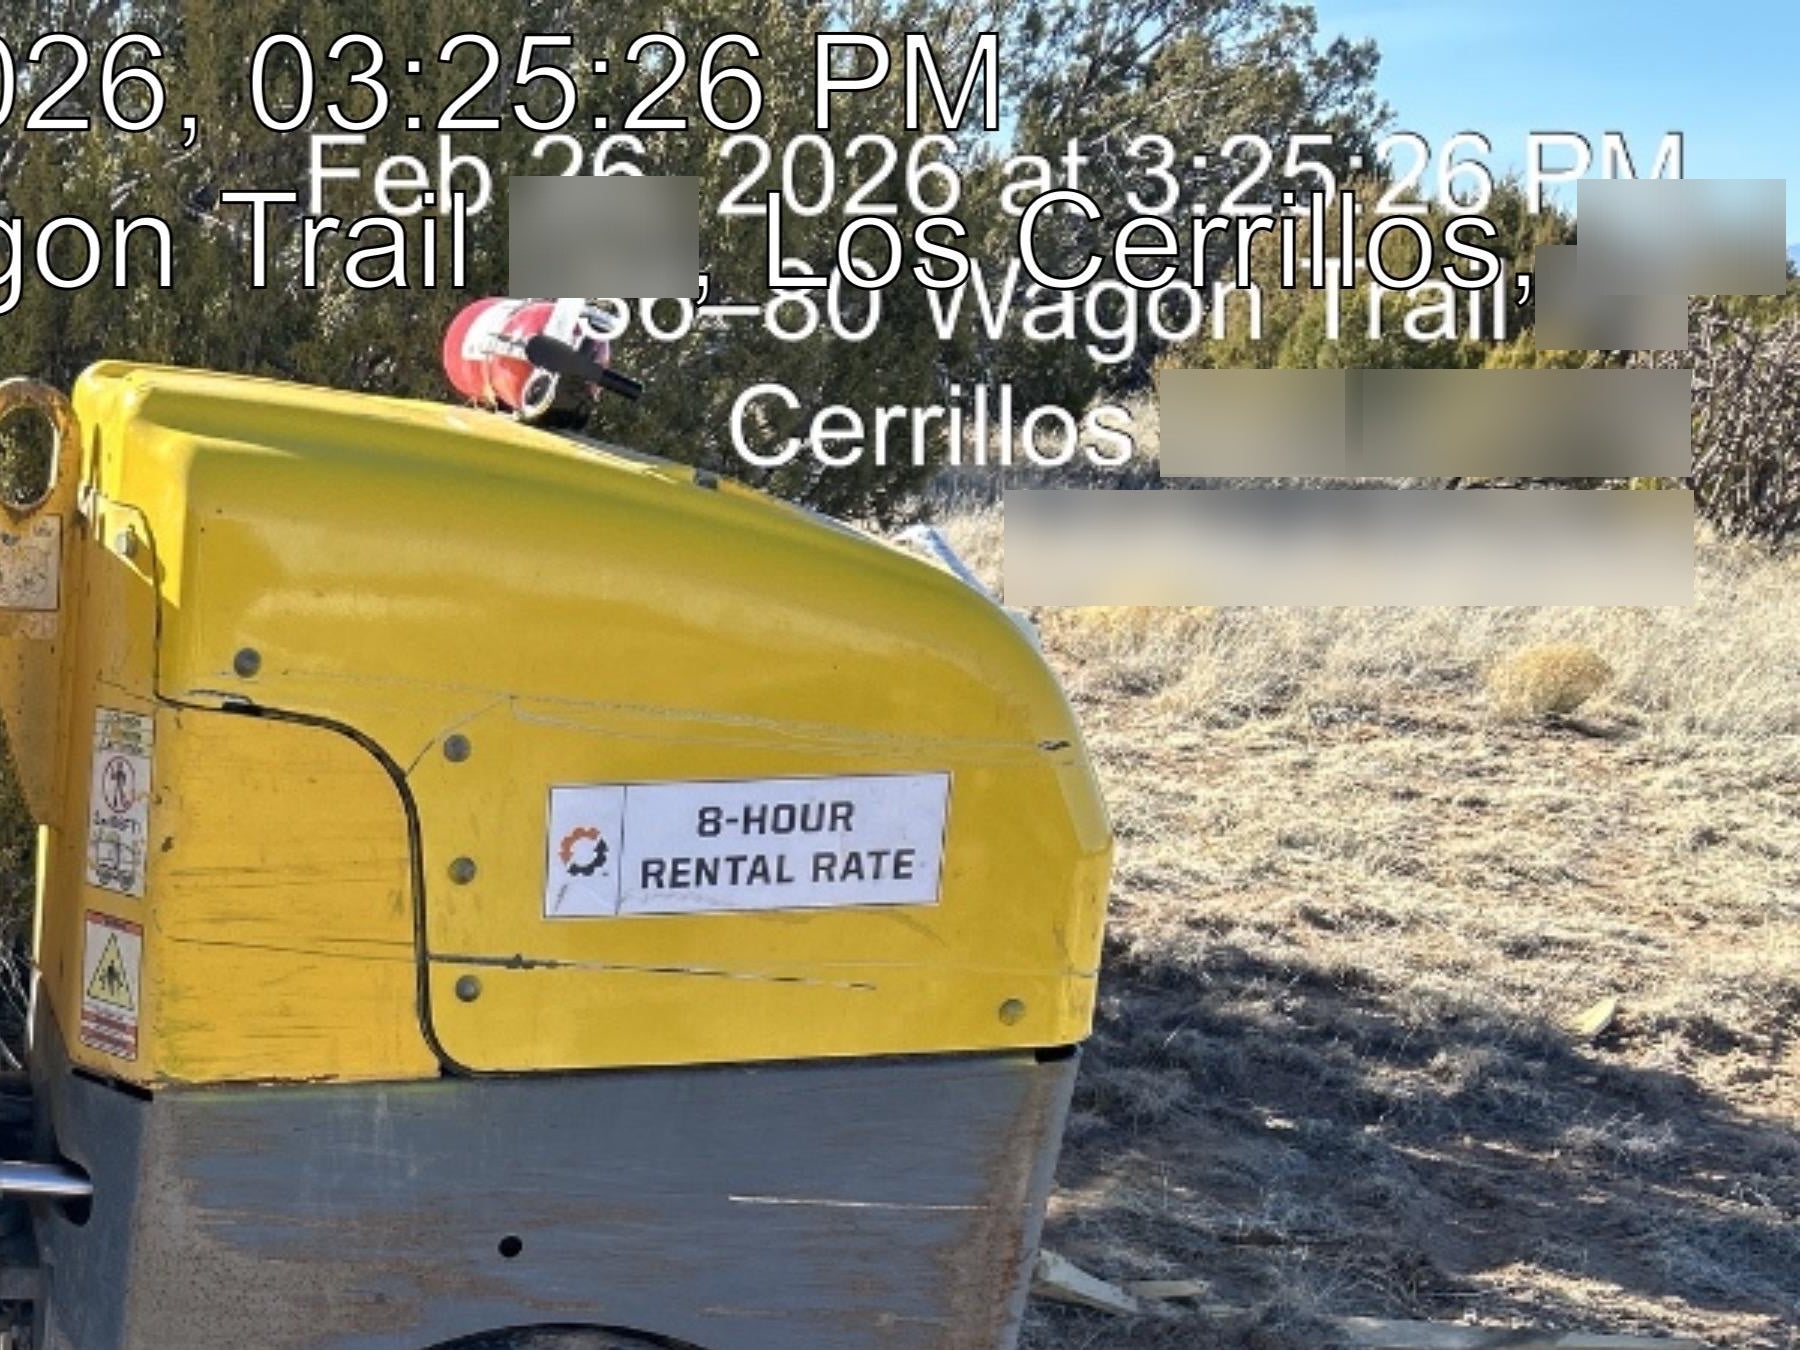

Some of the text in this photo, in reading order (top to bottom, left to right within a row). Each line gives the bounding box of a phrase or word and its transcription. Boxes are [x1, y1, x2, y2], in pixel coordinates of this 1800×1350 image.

[697, 801, 855, 838] 8-HOUR
[640, 848, 917, 890] RENTAL RATE
